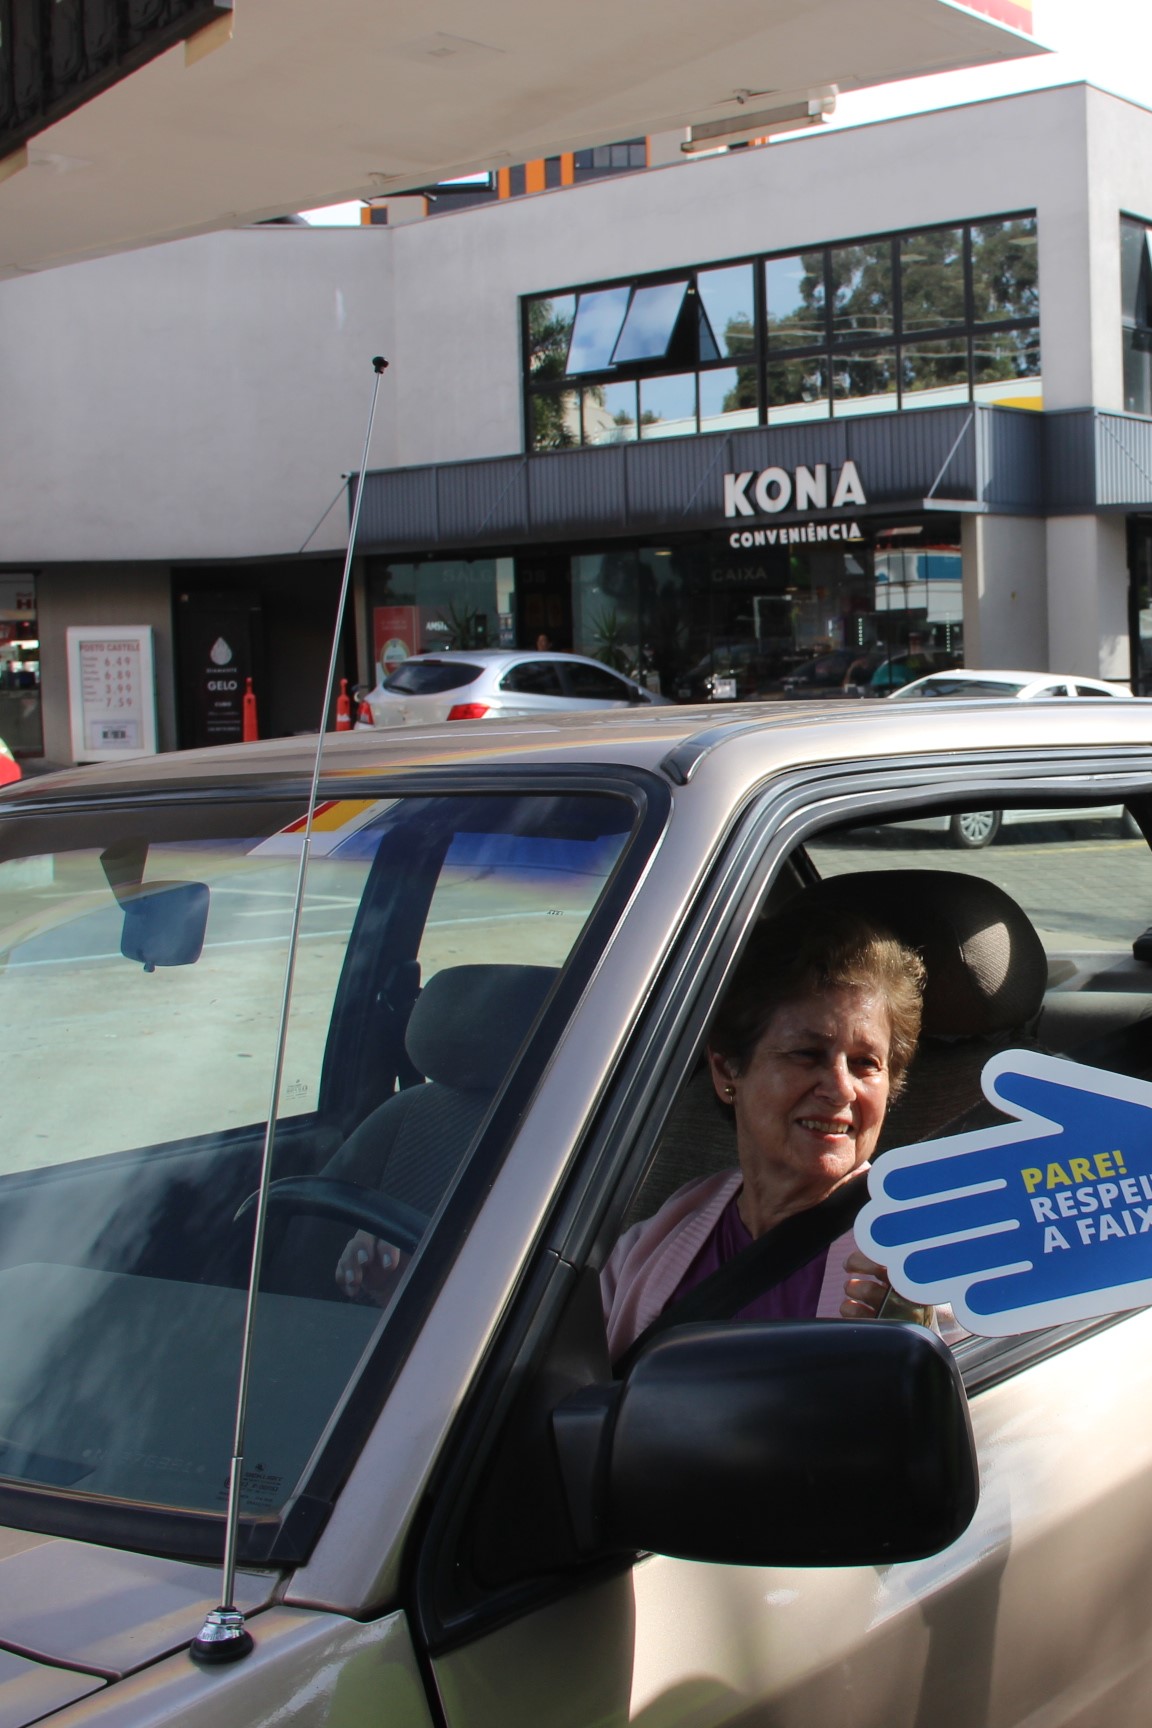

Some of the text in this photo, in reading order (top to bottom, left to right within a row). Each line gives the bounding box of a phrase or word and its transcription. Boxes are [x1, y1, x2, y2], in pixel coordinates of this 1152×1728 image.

[724, 460, 867, 518] KONA
[729, 522, 862, 548] CONVENIÊNCIA
[711, 566, 767, 582] CAIXA
[207, 680, 238, 691] GELO
[1020, 1149, 1128, 1194] PARE!
[1043, 1225, 1071, 1254] A
